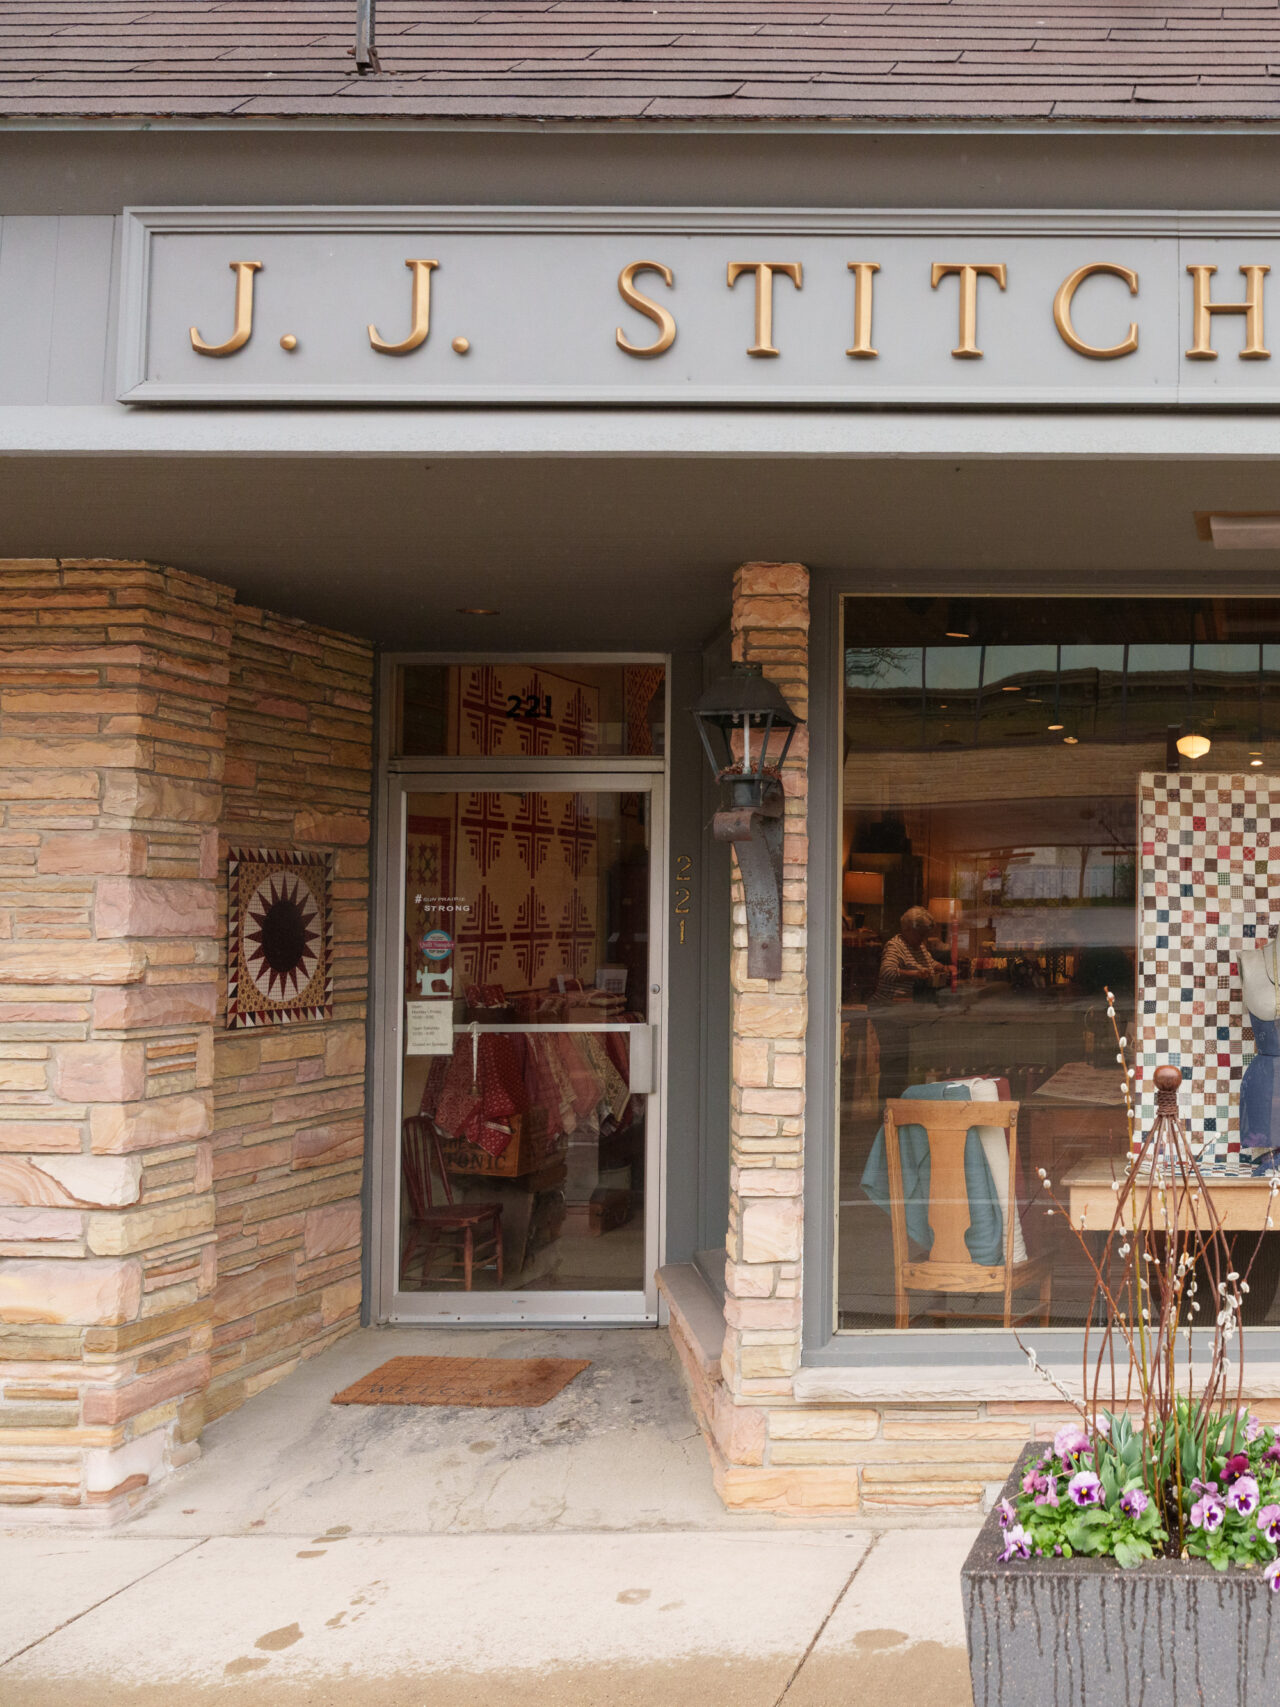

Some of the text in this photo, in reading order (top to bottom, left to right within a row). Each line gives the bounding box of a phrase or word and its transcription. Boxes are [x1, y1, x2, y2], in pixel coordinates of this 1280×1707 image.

[189, 260, 297, 357] J.
[368, 258, 470, 357] J.
[506, 694, 552, 718] 221
